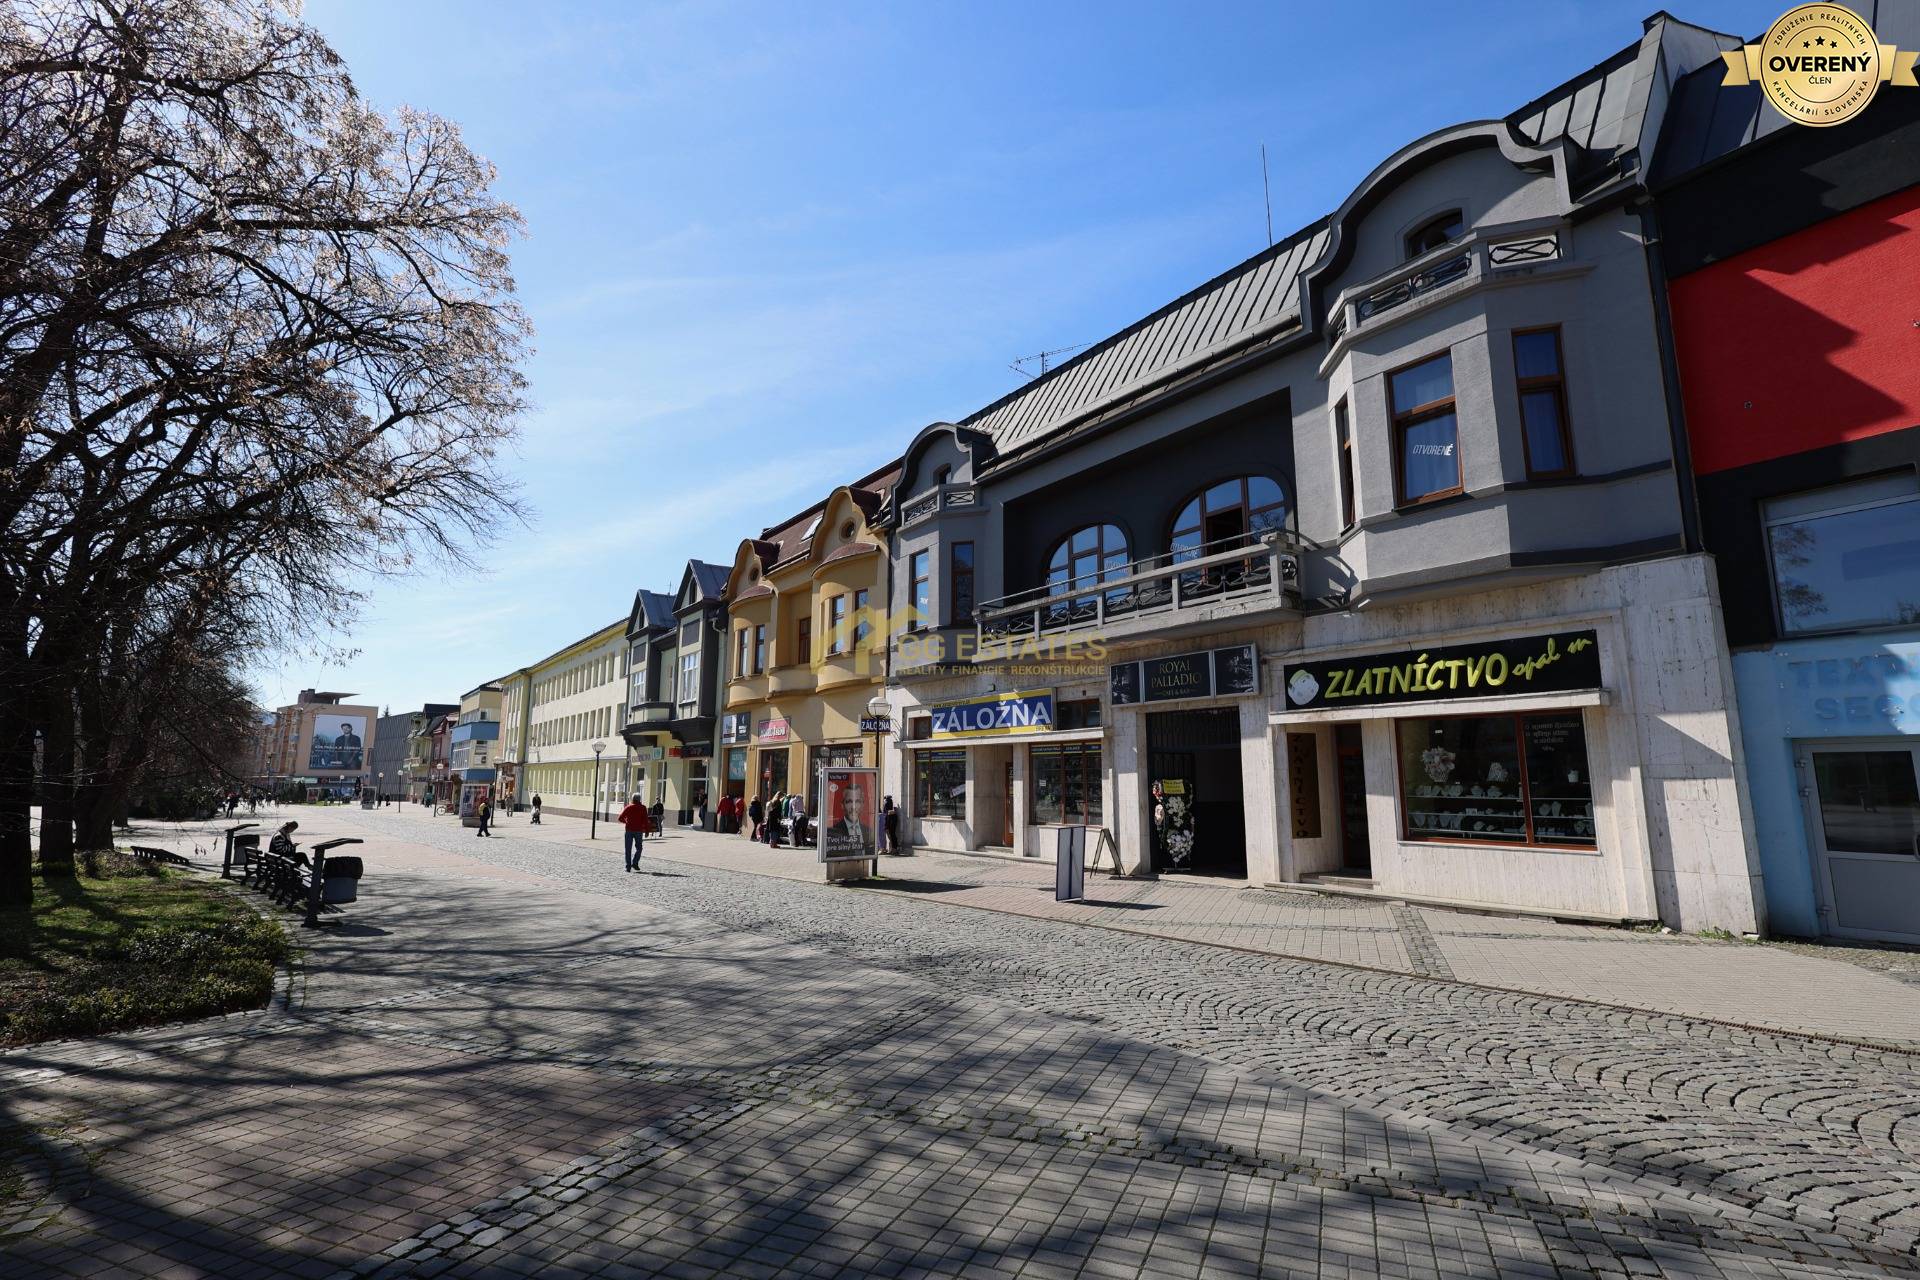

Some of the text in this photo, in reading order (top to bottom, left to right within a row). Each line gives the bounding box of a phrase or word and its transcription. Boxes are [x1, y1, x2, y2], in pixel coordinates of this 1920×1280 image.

[1412, 443, 1454, 456] OTVORENÉ
[1159, 658, 1191, 674] ROYAL
[1151, 672, 1202, 689] PALLADIO
[1324, 653, 1509, 699] ZLATNÍCTVO
[932, 699, 1052, 733] ZÁLOŽŇA
